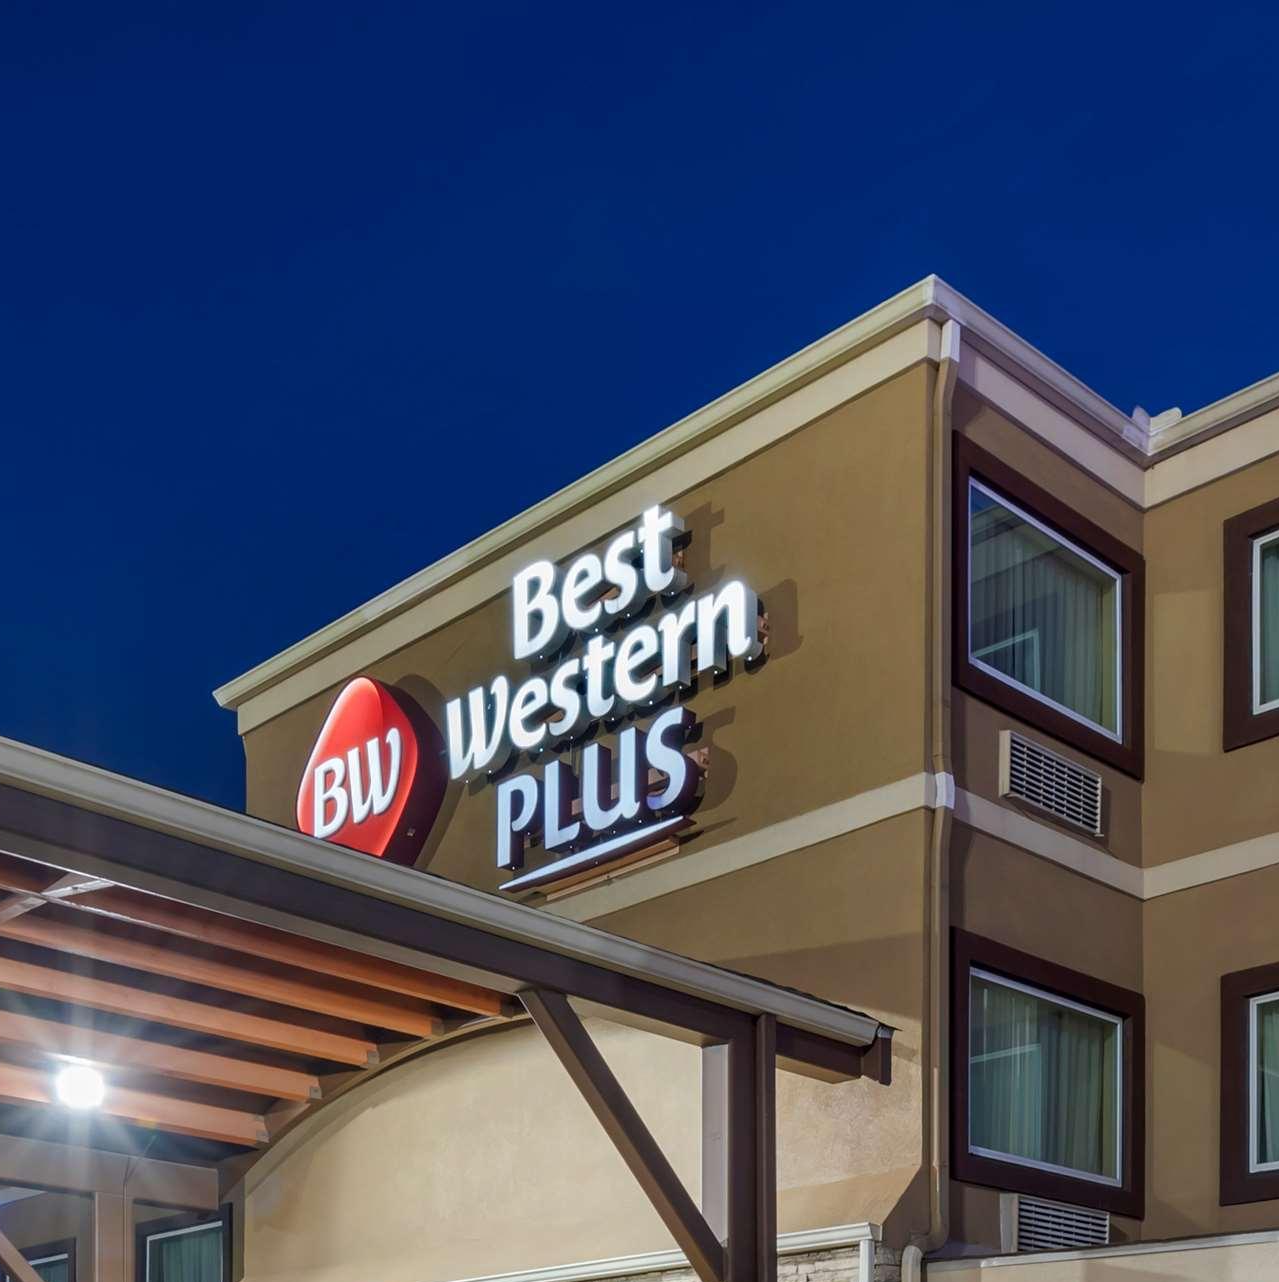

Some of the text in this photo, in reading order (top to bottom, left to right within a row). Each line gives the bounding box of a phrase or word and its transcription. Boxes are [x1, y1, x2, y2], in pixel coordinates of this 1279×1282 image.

[511, 503, 678, 660] Best
[446, 579, 756, 781] Western
[312, 727, 402, 839] BW
[496, 705, 690, 868] PLUS
